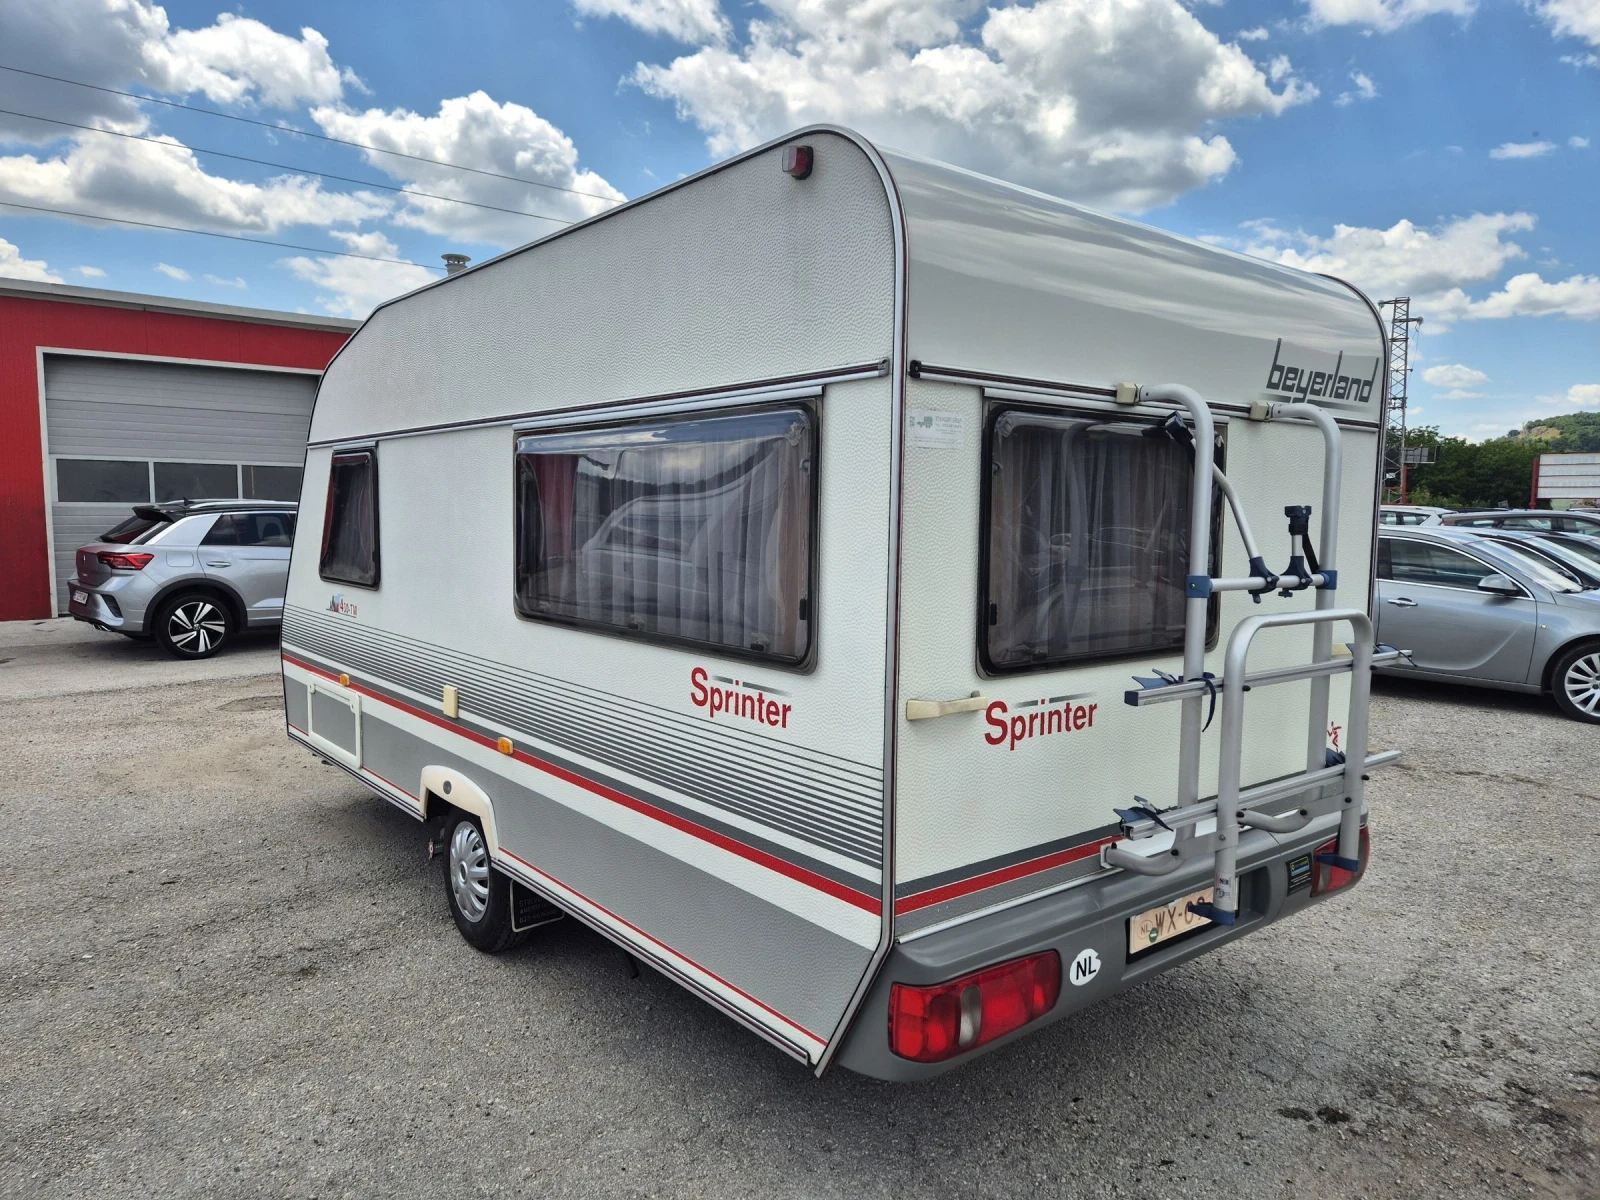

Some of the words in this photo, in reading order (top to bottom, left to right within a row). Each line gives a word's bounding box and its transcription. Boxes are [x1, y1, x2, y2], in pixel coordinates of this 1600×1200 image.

[1266, 338, 1379, 403] beyerland
[690, 667, 791, 728] Sprinter
[984, 699, 1097, 751] Sprinter
[1076, 956, 1097, 980] NL
